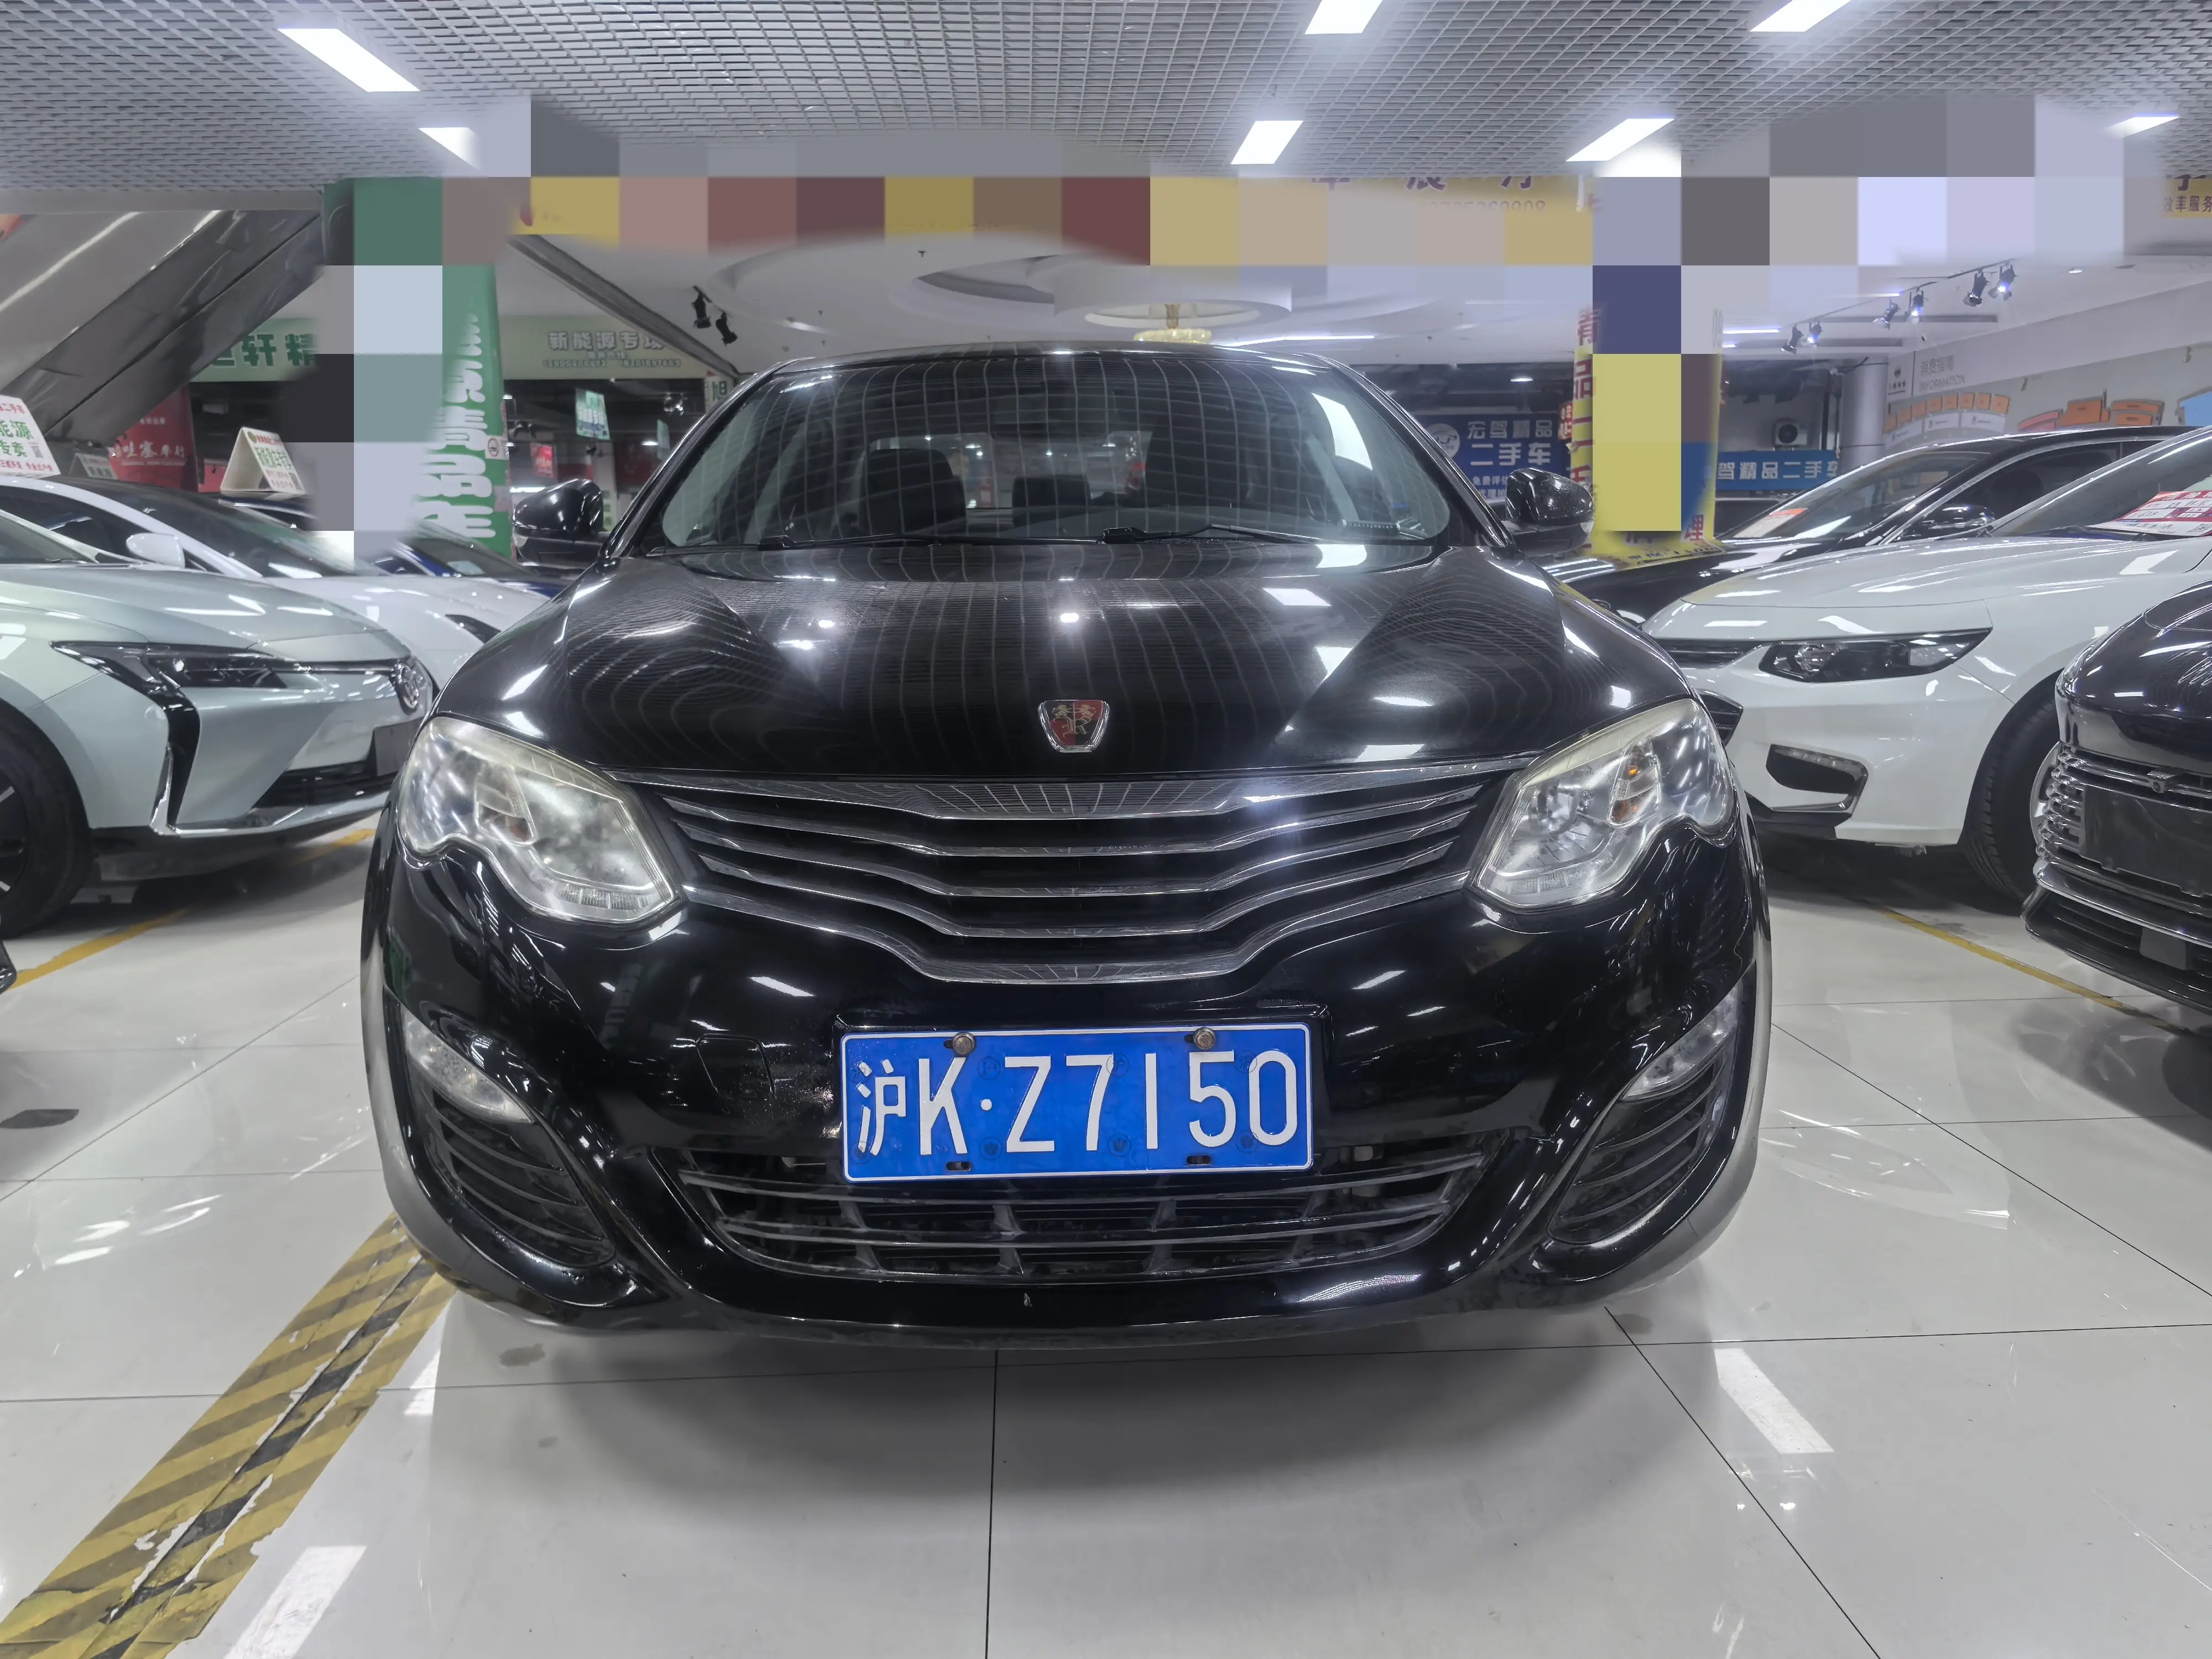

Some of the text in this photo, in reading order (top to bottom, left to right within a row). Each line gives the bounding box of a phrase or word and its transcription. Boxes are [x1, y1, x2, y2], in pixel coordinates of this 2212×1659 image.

[1470, 443, 1551, 466] 二手车
[857, 1050, 1298, 1156] 沪K·Z7150
